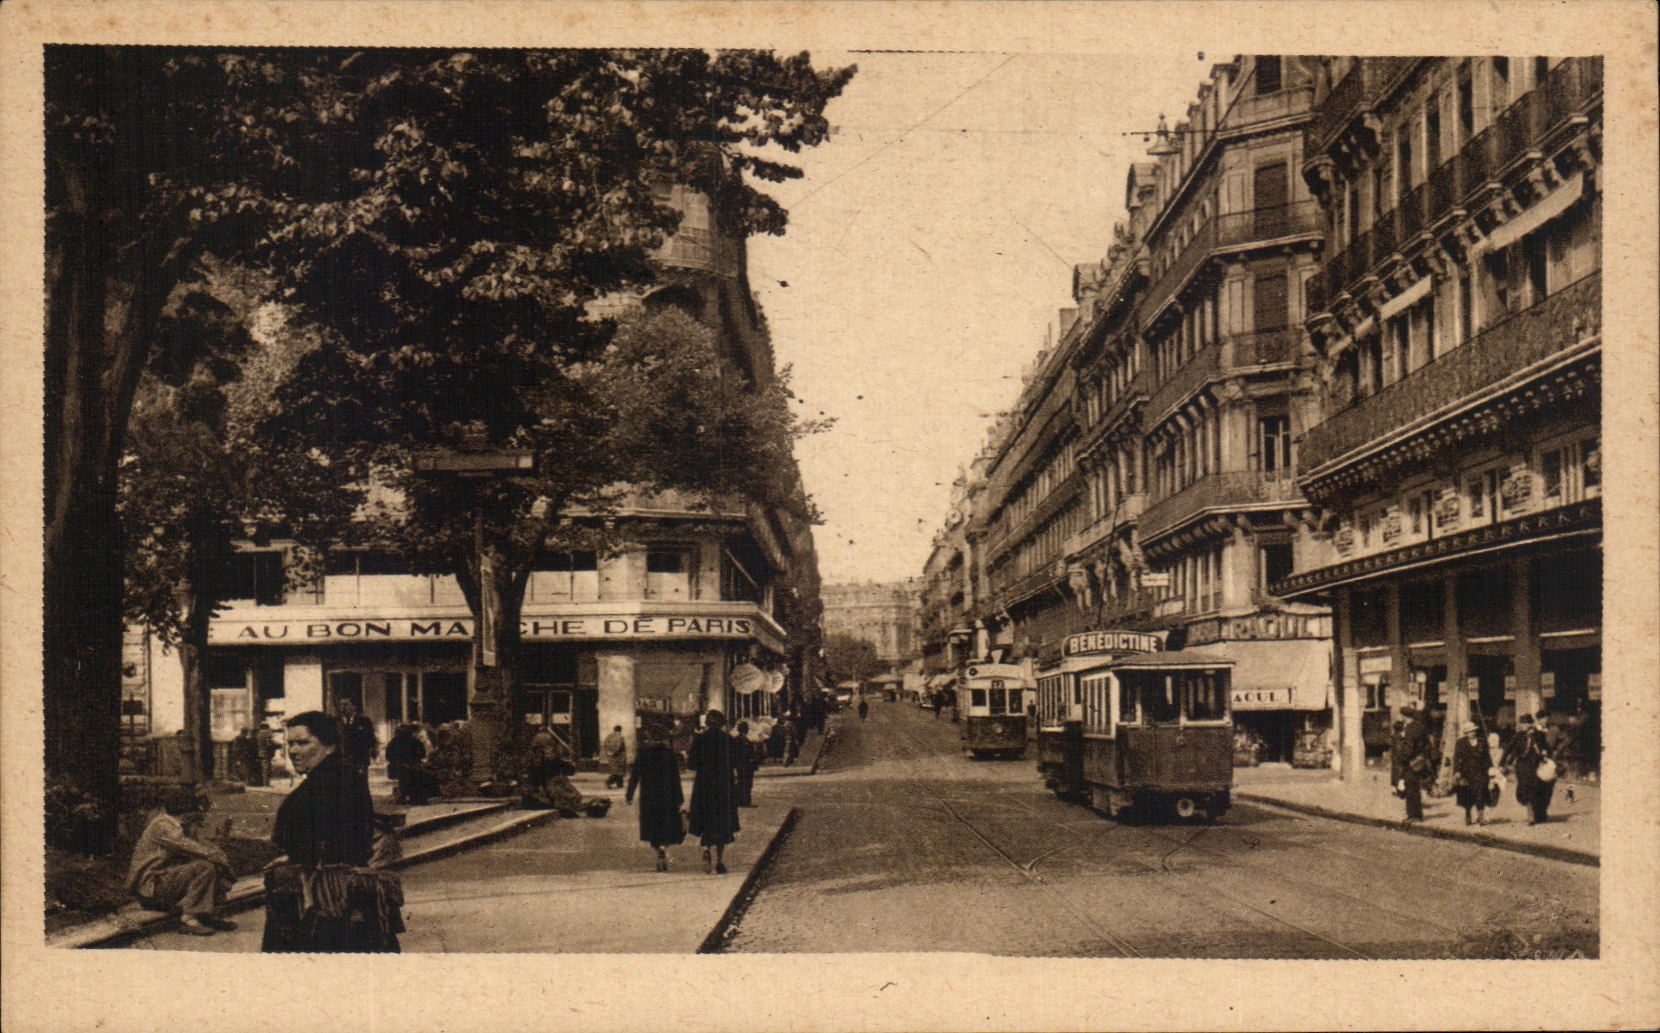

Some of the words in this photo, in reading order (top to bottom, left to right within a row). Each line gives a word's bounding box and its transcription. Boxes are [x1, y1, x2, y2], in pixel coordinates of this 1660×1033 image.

[237, 625, 289, 639] AU
[306, 622, 391, 638] BON
[667, 618, 752, 633] PARIS
